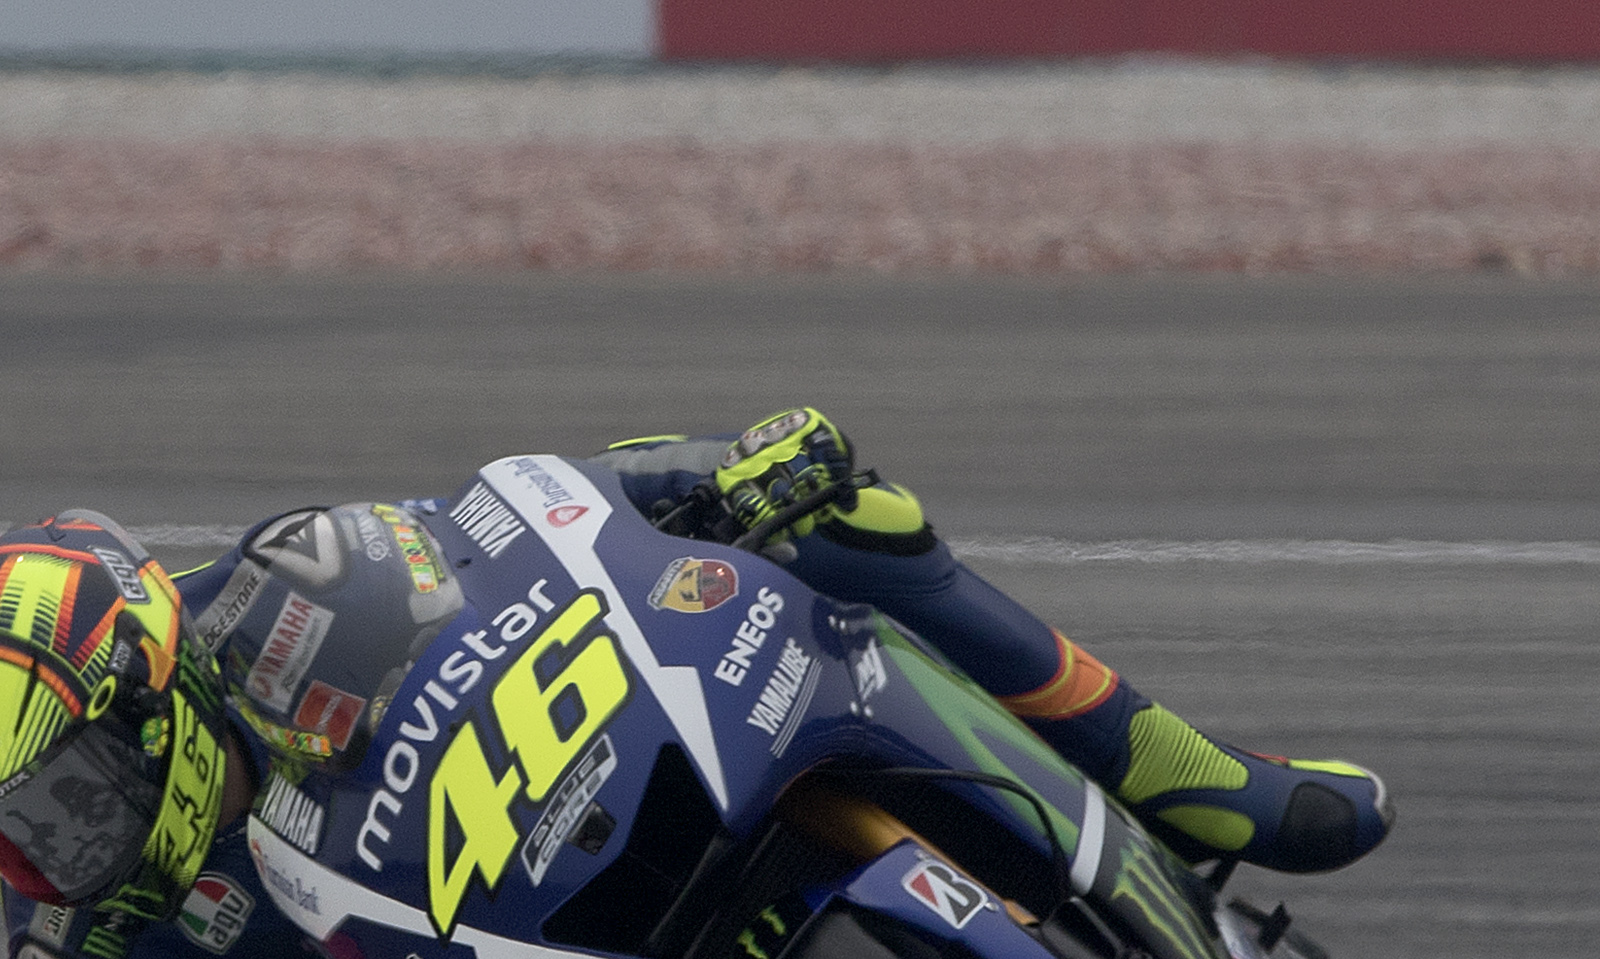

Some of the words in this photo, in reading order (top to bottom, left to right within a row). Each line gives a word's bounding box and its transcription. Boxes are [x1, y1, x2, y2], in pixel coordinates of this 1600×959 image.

[449, 480, 527, 558] YAMAHA
[204, 569, 262, 647] DGESTONE
[255, 599, 313, 676] YAMAHA
[714, 586, 785, 687] ENEOS
[356, 578, 557, 872] movistar
[746, 636, 811, 736] YAMALUBE
[426, 589, 632, 938] 46
[533, 755, 596, 848] BLUE
[260, 771, 324, 855] YAMAHA
[540, 771, 602, 864] CORE
